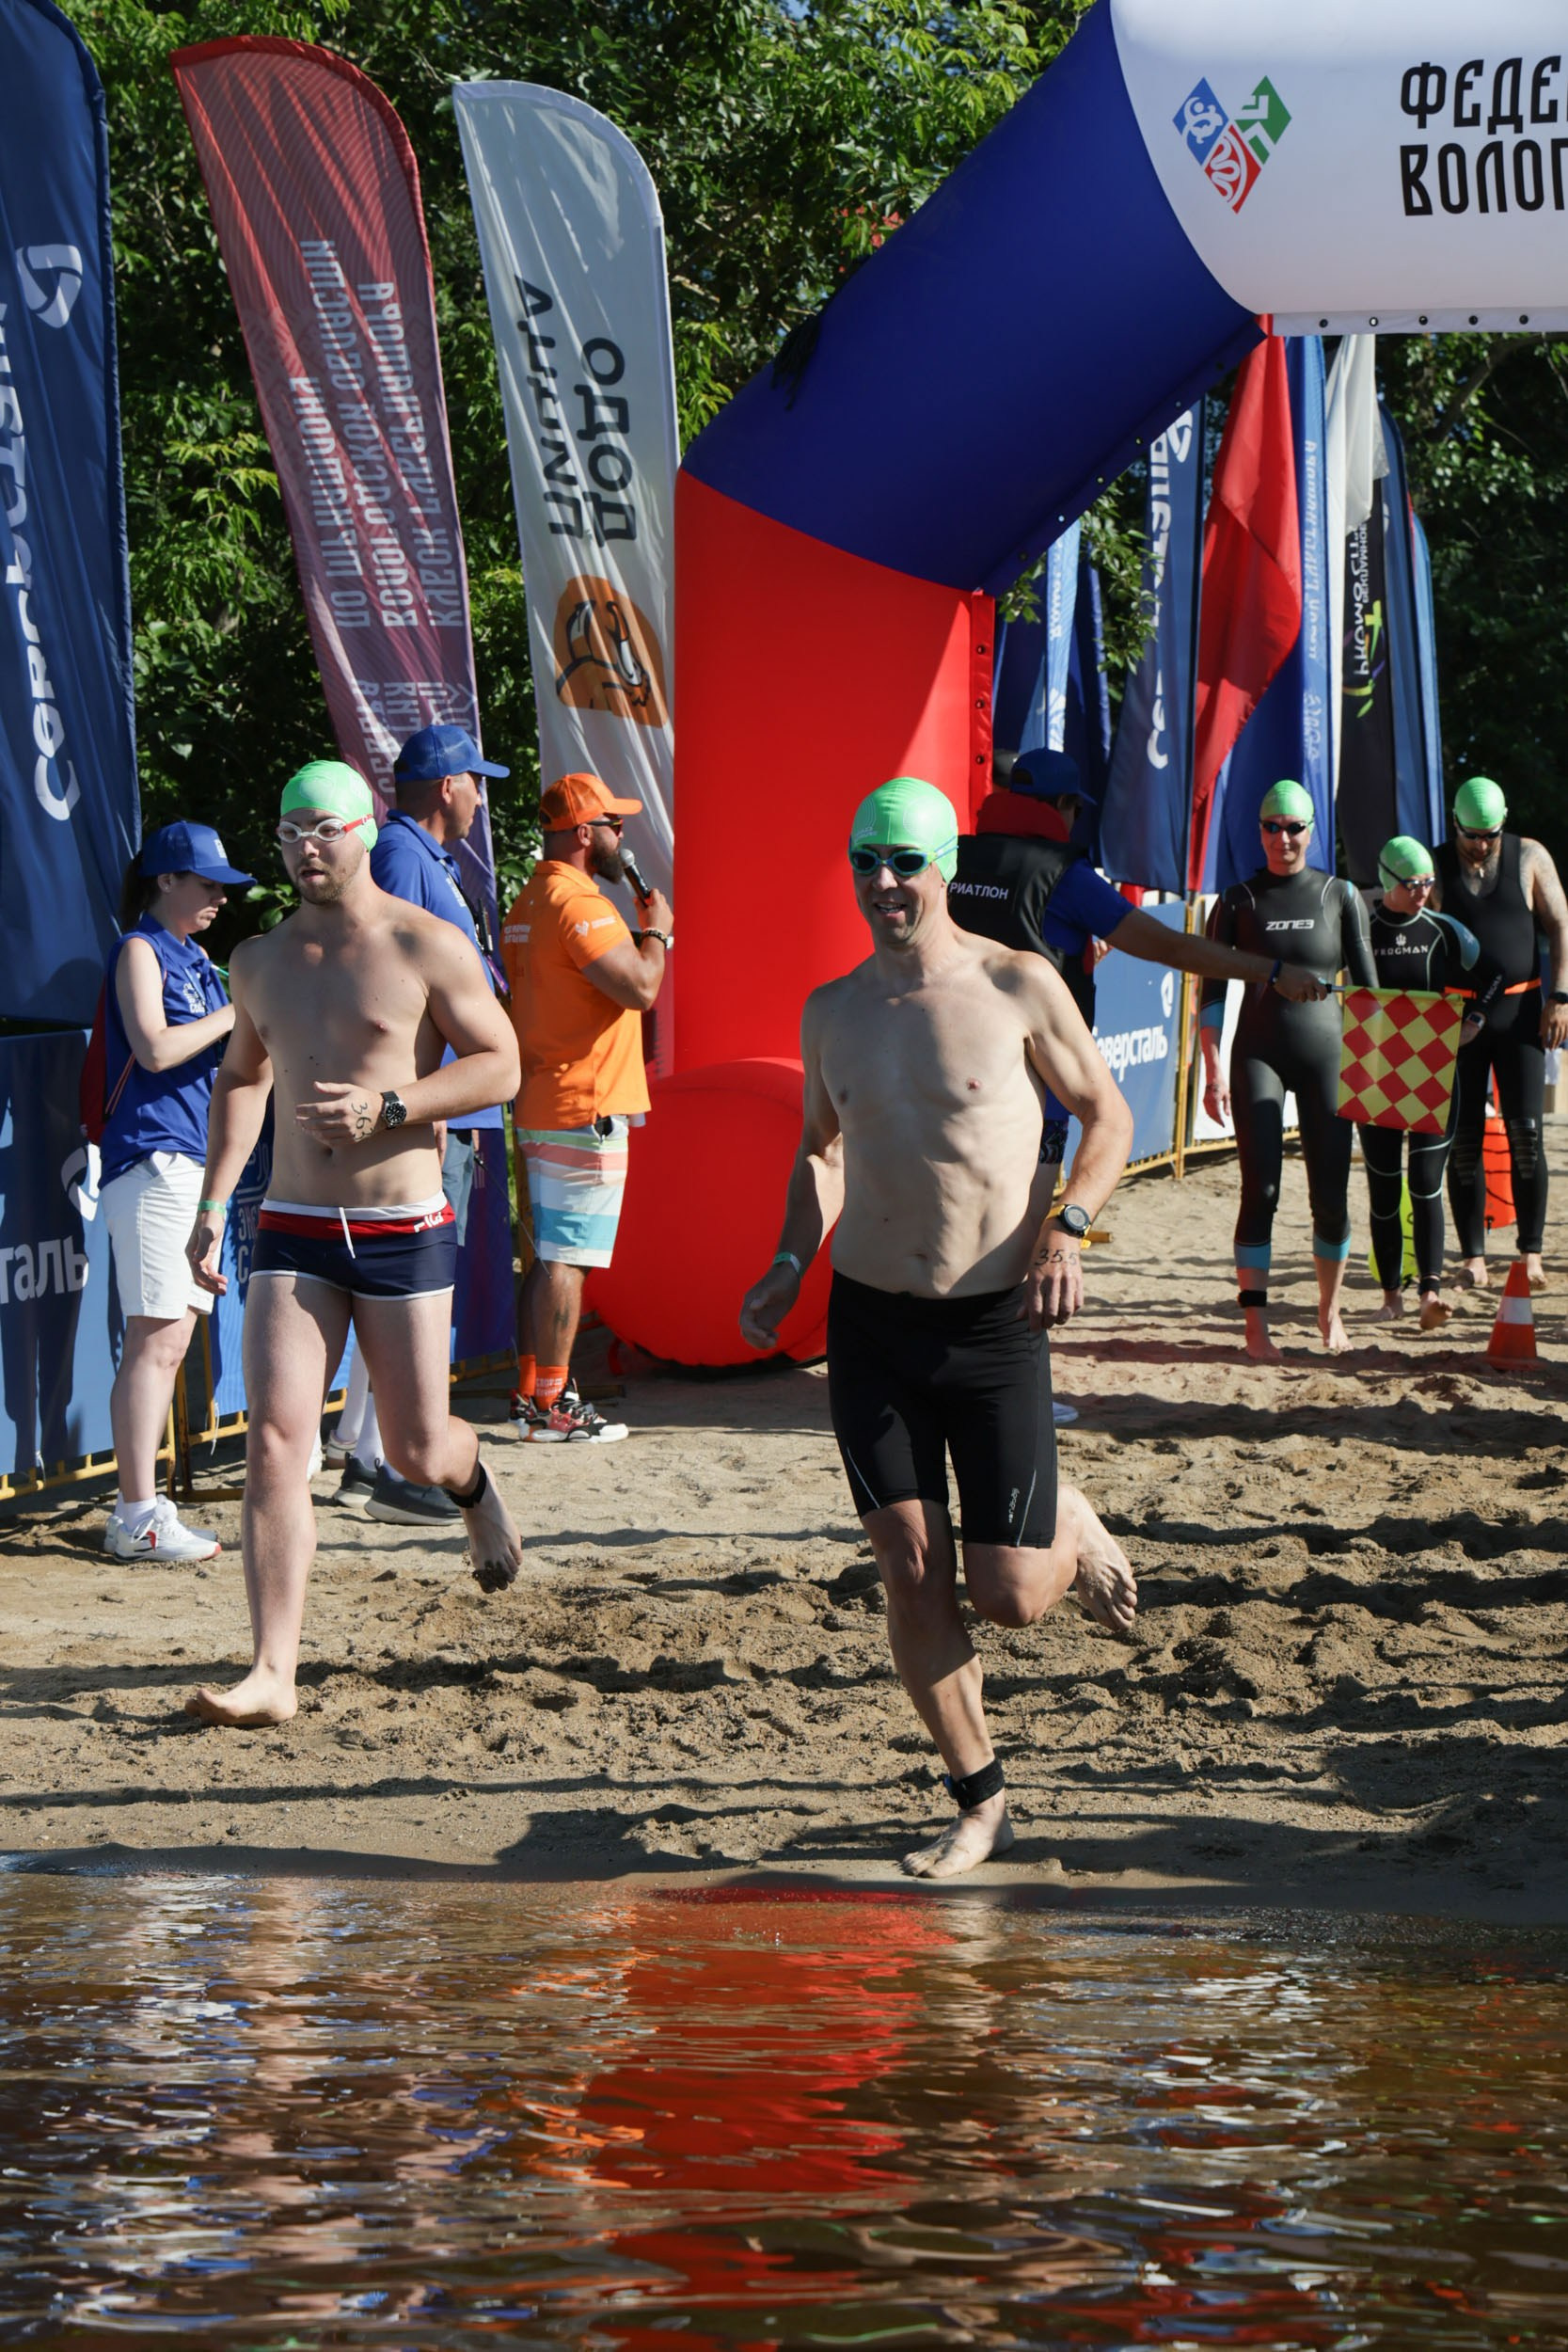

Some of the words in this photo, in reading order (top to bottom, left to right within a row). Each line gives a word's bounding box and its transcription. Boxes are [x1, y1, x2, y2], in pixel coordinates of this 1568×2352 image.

[1400, 55, 1568, 135] ФЕДЕ
[948, 882, 1009, 900] РИАТЛОН
[1265, 918, 1315, 931] ZONE3
[1373, 945, 1429, 957] FROGMAN
[1091, 1025, 1169, 1083] еверсталь
